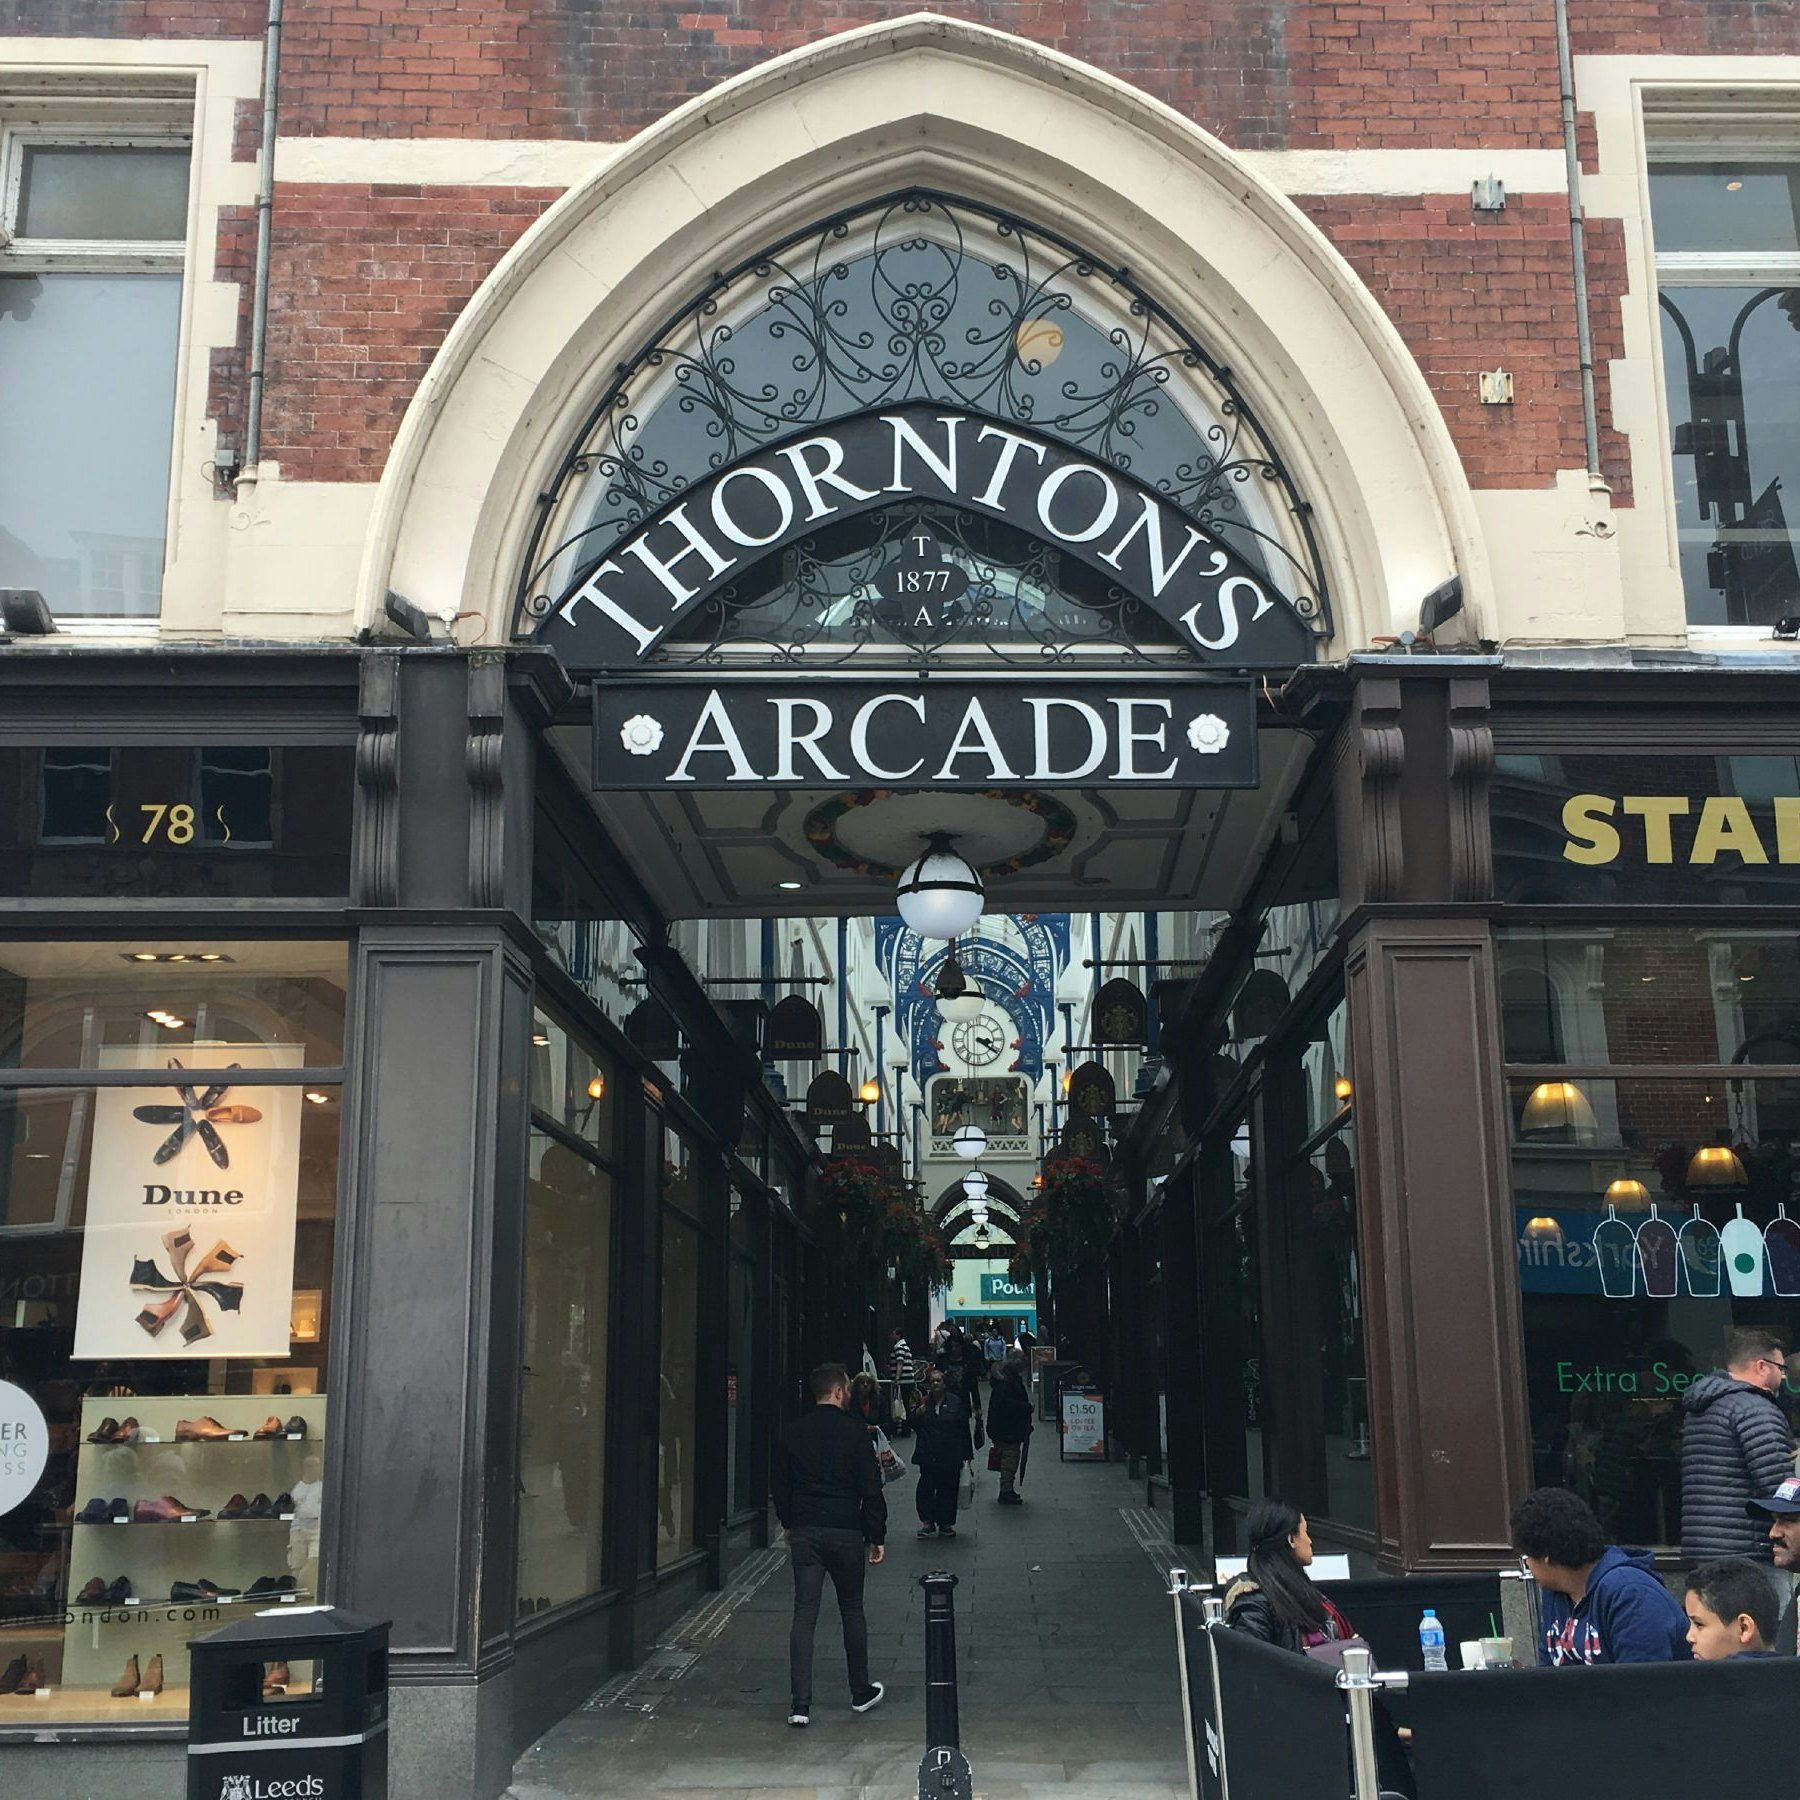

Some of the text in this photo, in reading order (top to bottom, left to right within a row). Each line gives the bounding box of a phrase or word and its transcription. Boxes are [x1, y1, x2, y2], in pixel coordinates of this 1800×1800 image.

[560, 416, 1275, 656] THORNTON'S
[912, 536, 931, 557] T
[897, 571, 950, 593] 1877
[913, 605, 934, 626] A
[664, 689, 1180, 781] ARCADE
[141, 803, 195, 845] 78
[773, 1040, 816, 1050] Dune
[813, 1108, 848, 1117] Dune
[142, 1184, 244, 1205] Dune
[1556, 1362, 1637, 1393] Extra
[243, 1716, 300, 1736] Litter
[255, 1774, 324, 1799] Leeds
